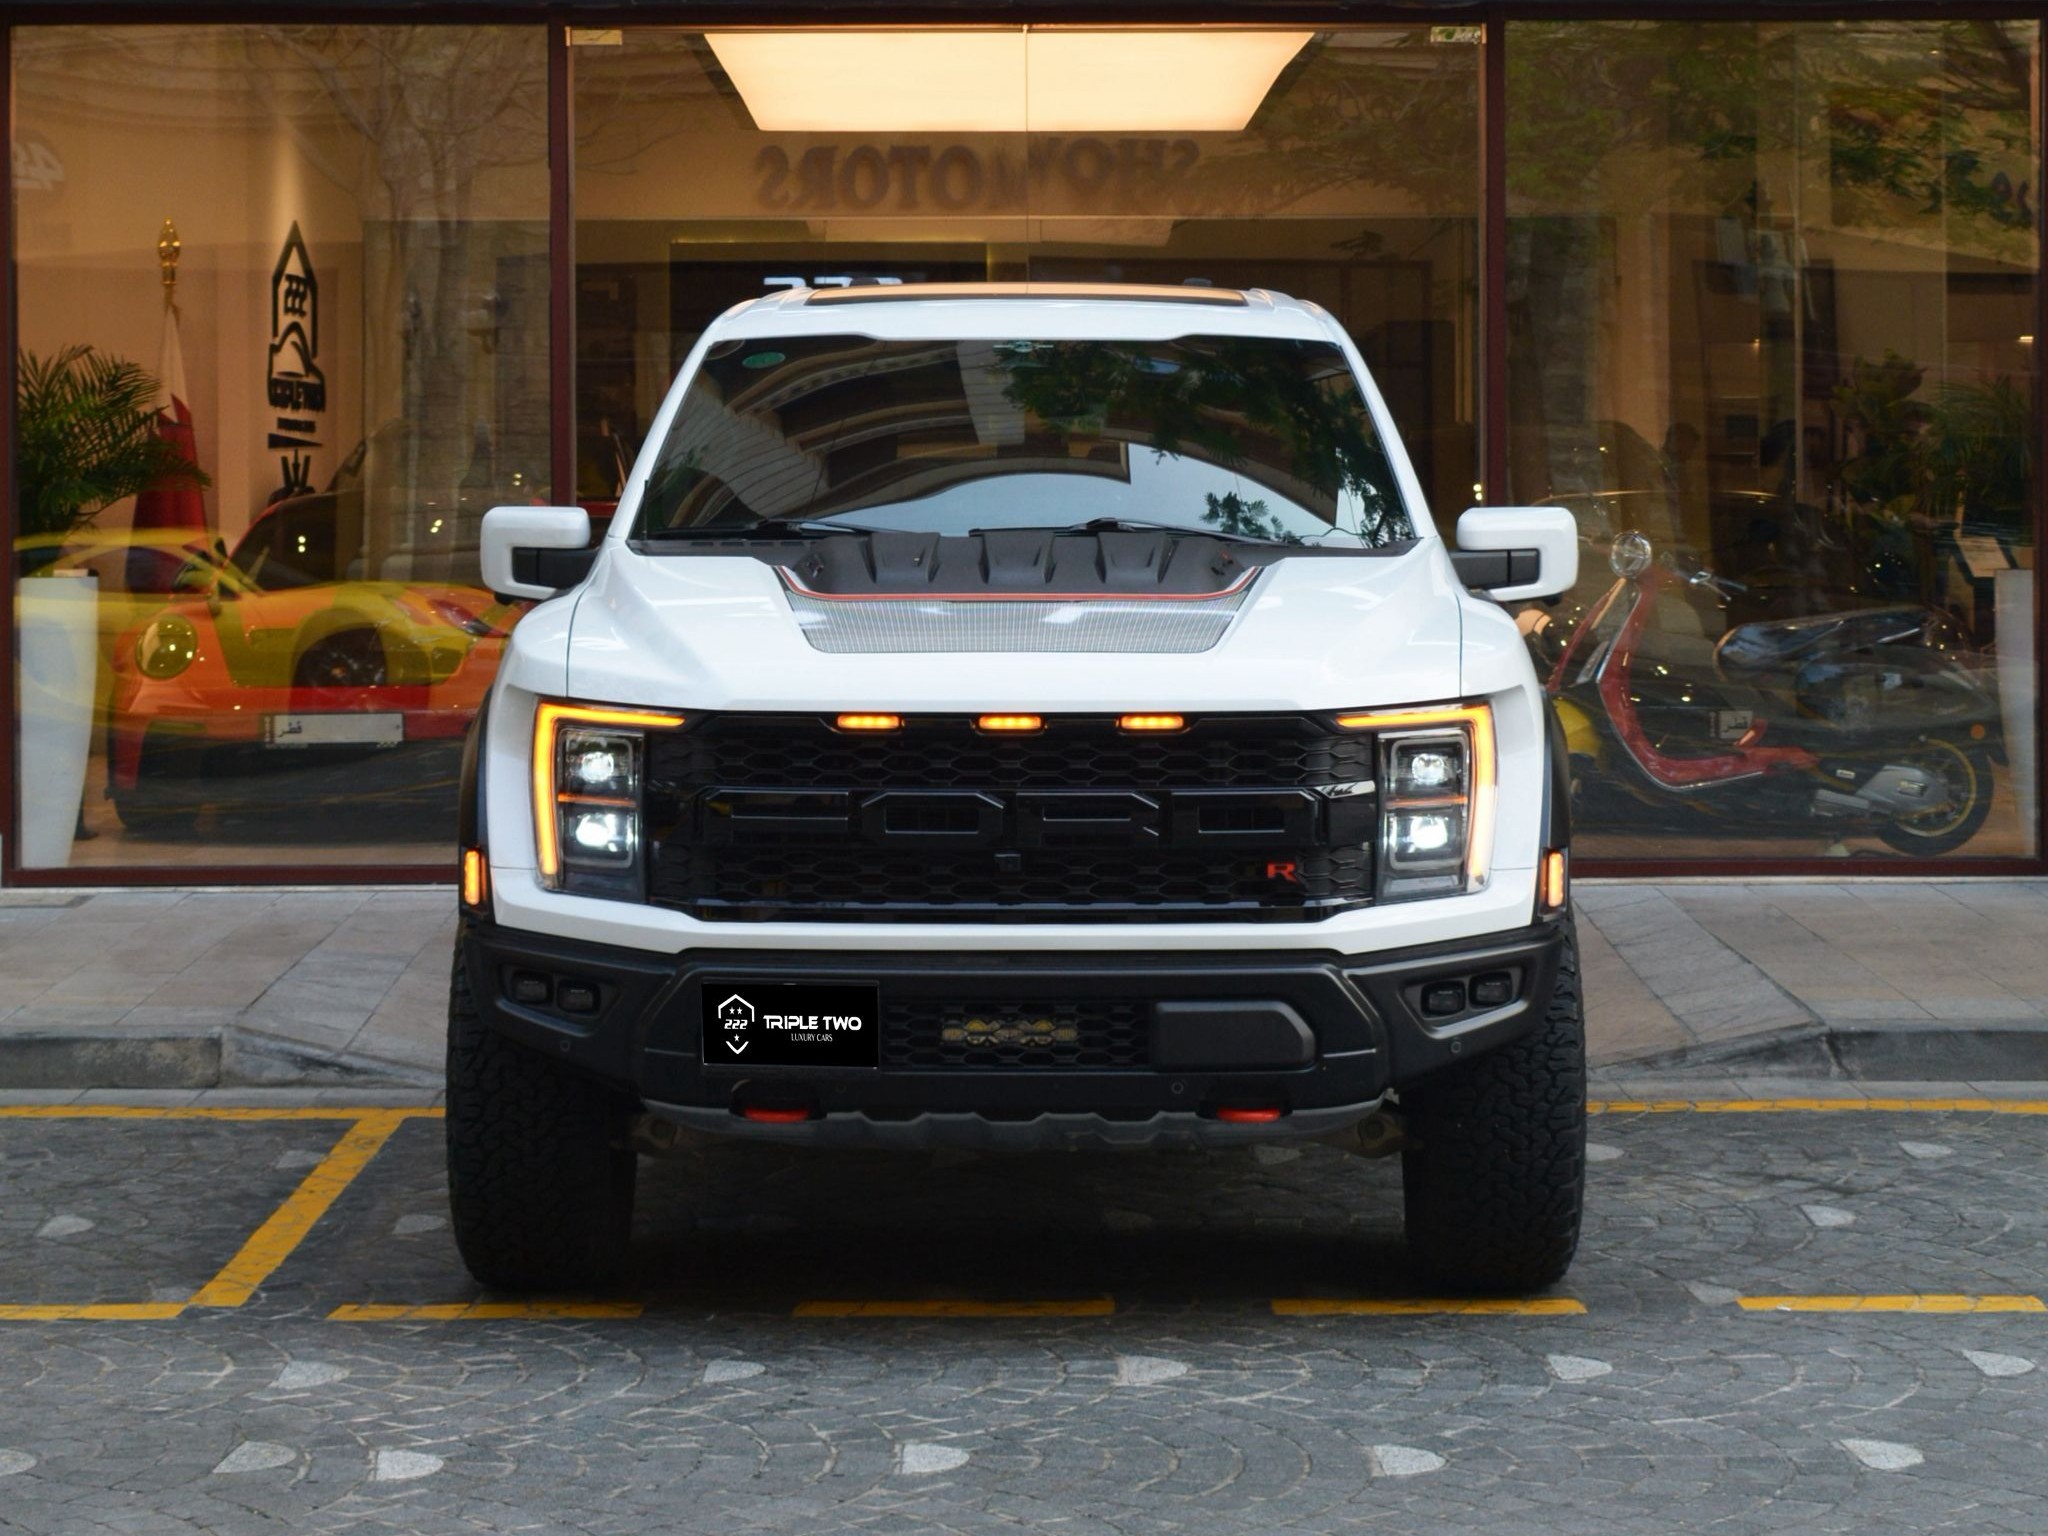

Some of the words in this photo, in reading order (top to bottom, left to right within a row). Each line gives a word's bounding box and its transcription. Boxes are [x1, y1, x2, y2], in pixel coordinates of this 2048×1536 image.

[702, 785, 1321, 847] FORD
[1266, 861, 1298, 881] R
[724, 1019, 748, 1030] 222
[763, 1015, 819, 1030] TRIPLE
[823, 1016, 862, 1031] TWO
[791, 1033, 816, 1042] LUXURY
[817, 1033, 833, 1042] CARS
